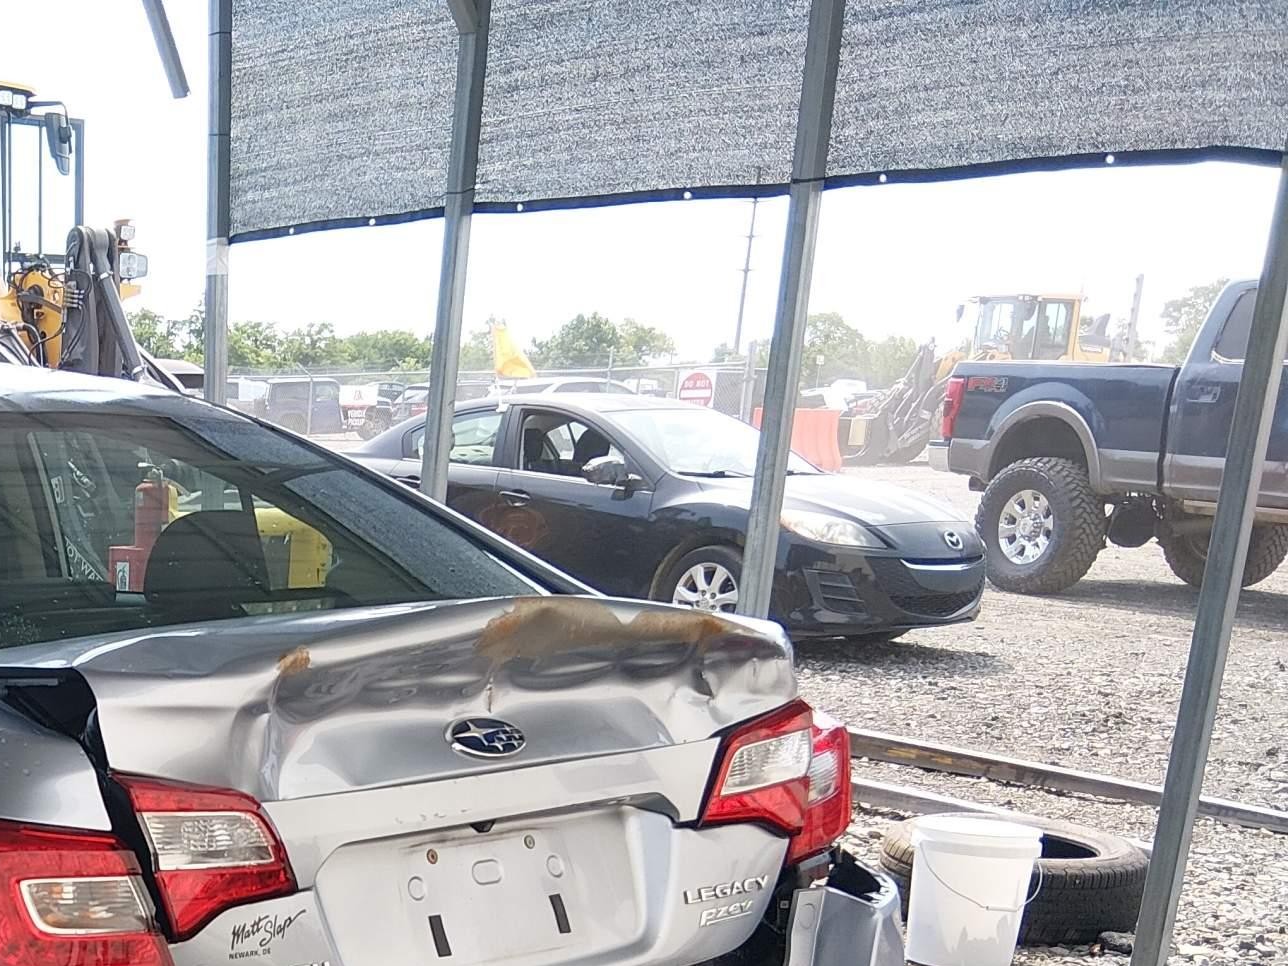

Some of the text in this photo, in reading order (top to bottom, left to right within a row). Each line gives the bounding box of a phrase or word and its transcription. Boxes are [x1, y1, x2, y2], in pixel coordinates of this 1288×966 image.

[683, 874, 768, 905] LEGACY
[230, 908, 307, 951] Matt Slap
[228, 947, 271, 960] NEWARK, DE
